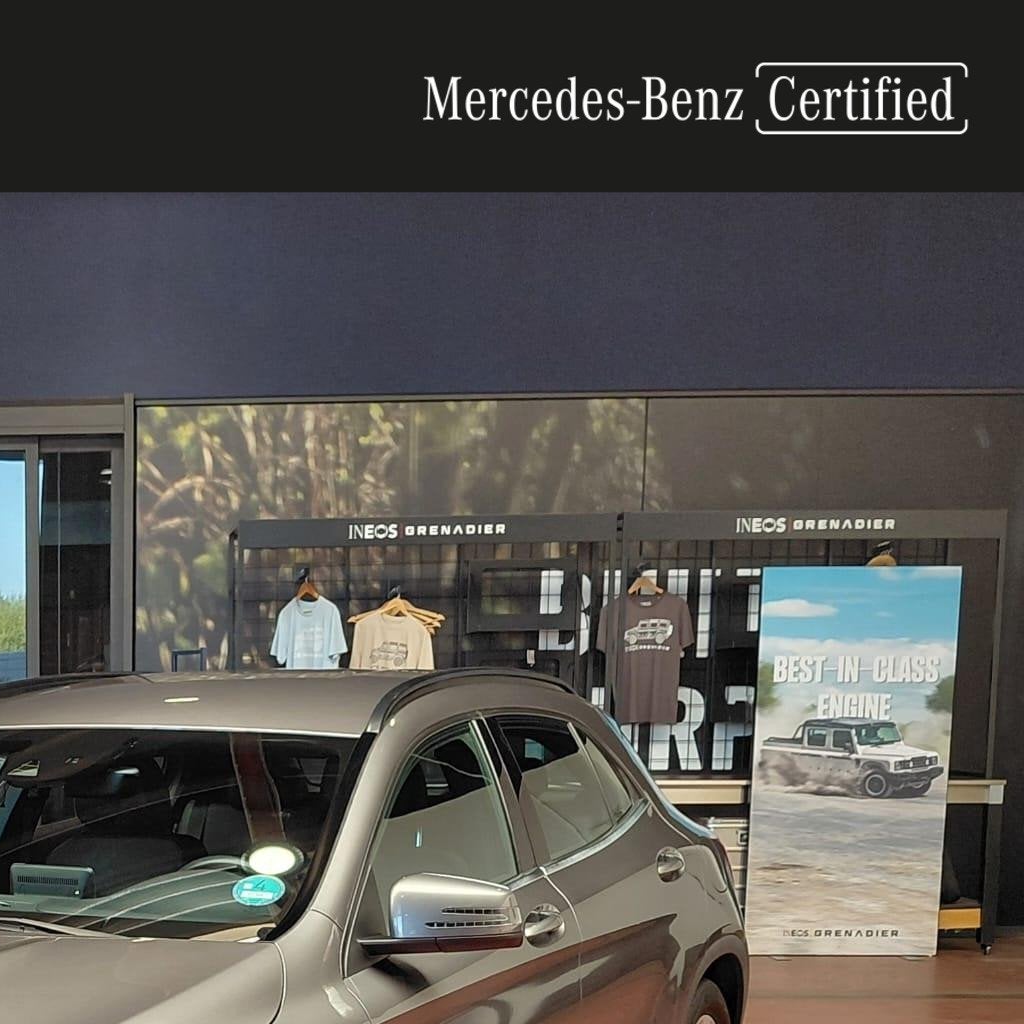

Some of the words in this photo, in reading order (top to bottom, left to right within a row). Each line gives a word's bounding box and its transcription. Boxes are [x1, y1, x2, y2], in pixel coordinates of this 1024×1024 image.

[348, 523, 398, 540] INEOS
[405, 523, 506, 536] GRENADIER
[735, 517, 787, 533] INEOS
[793, 518, 896, 530] GRENADIER
[817, 692, 892, 721] ENGINE
[814, 929, 899, 937] GRENADIER
